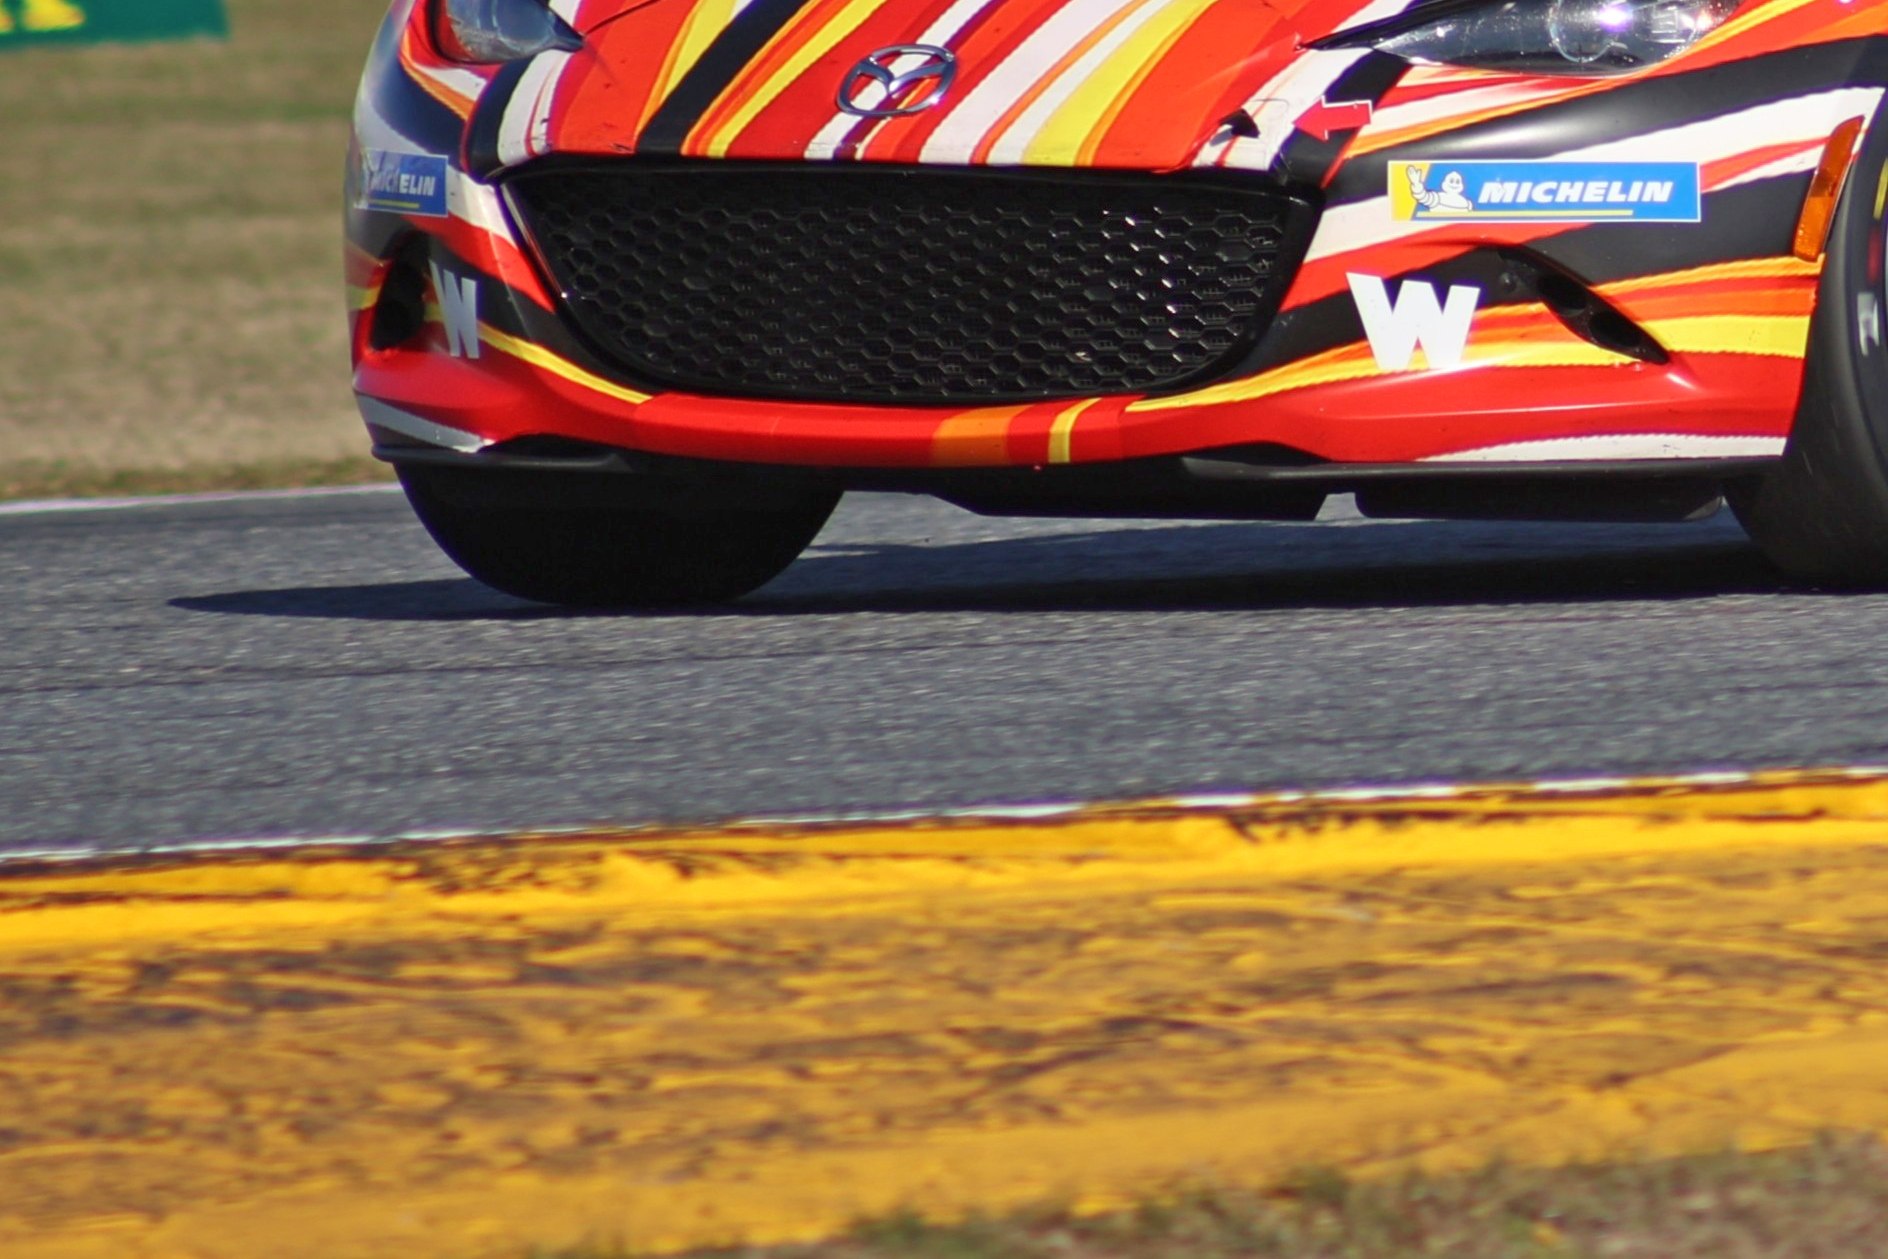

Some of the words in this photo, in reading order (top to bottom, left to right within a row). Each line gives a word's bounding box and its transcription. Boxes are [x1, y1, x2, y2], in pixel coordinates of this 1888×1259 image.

[1478, 181, 1674, 204] MICHELIN
[428, 258, 480, 359] W
[1346, 272, 1481, 370] W
